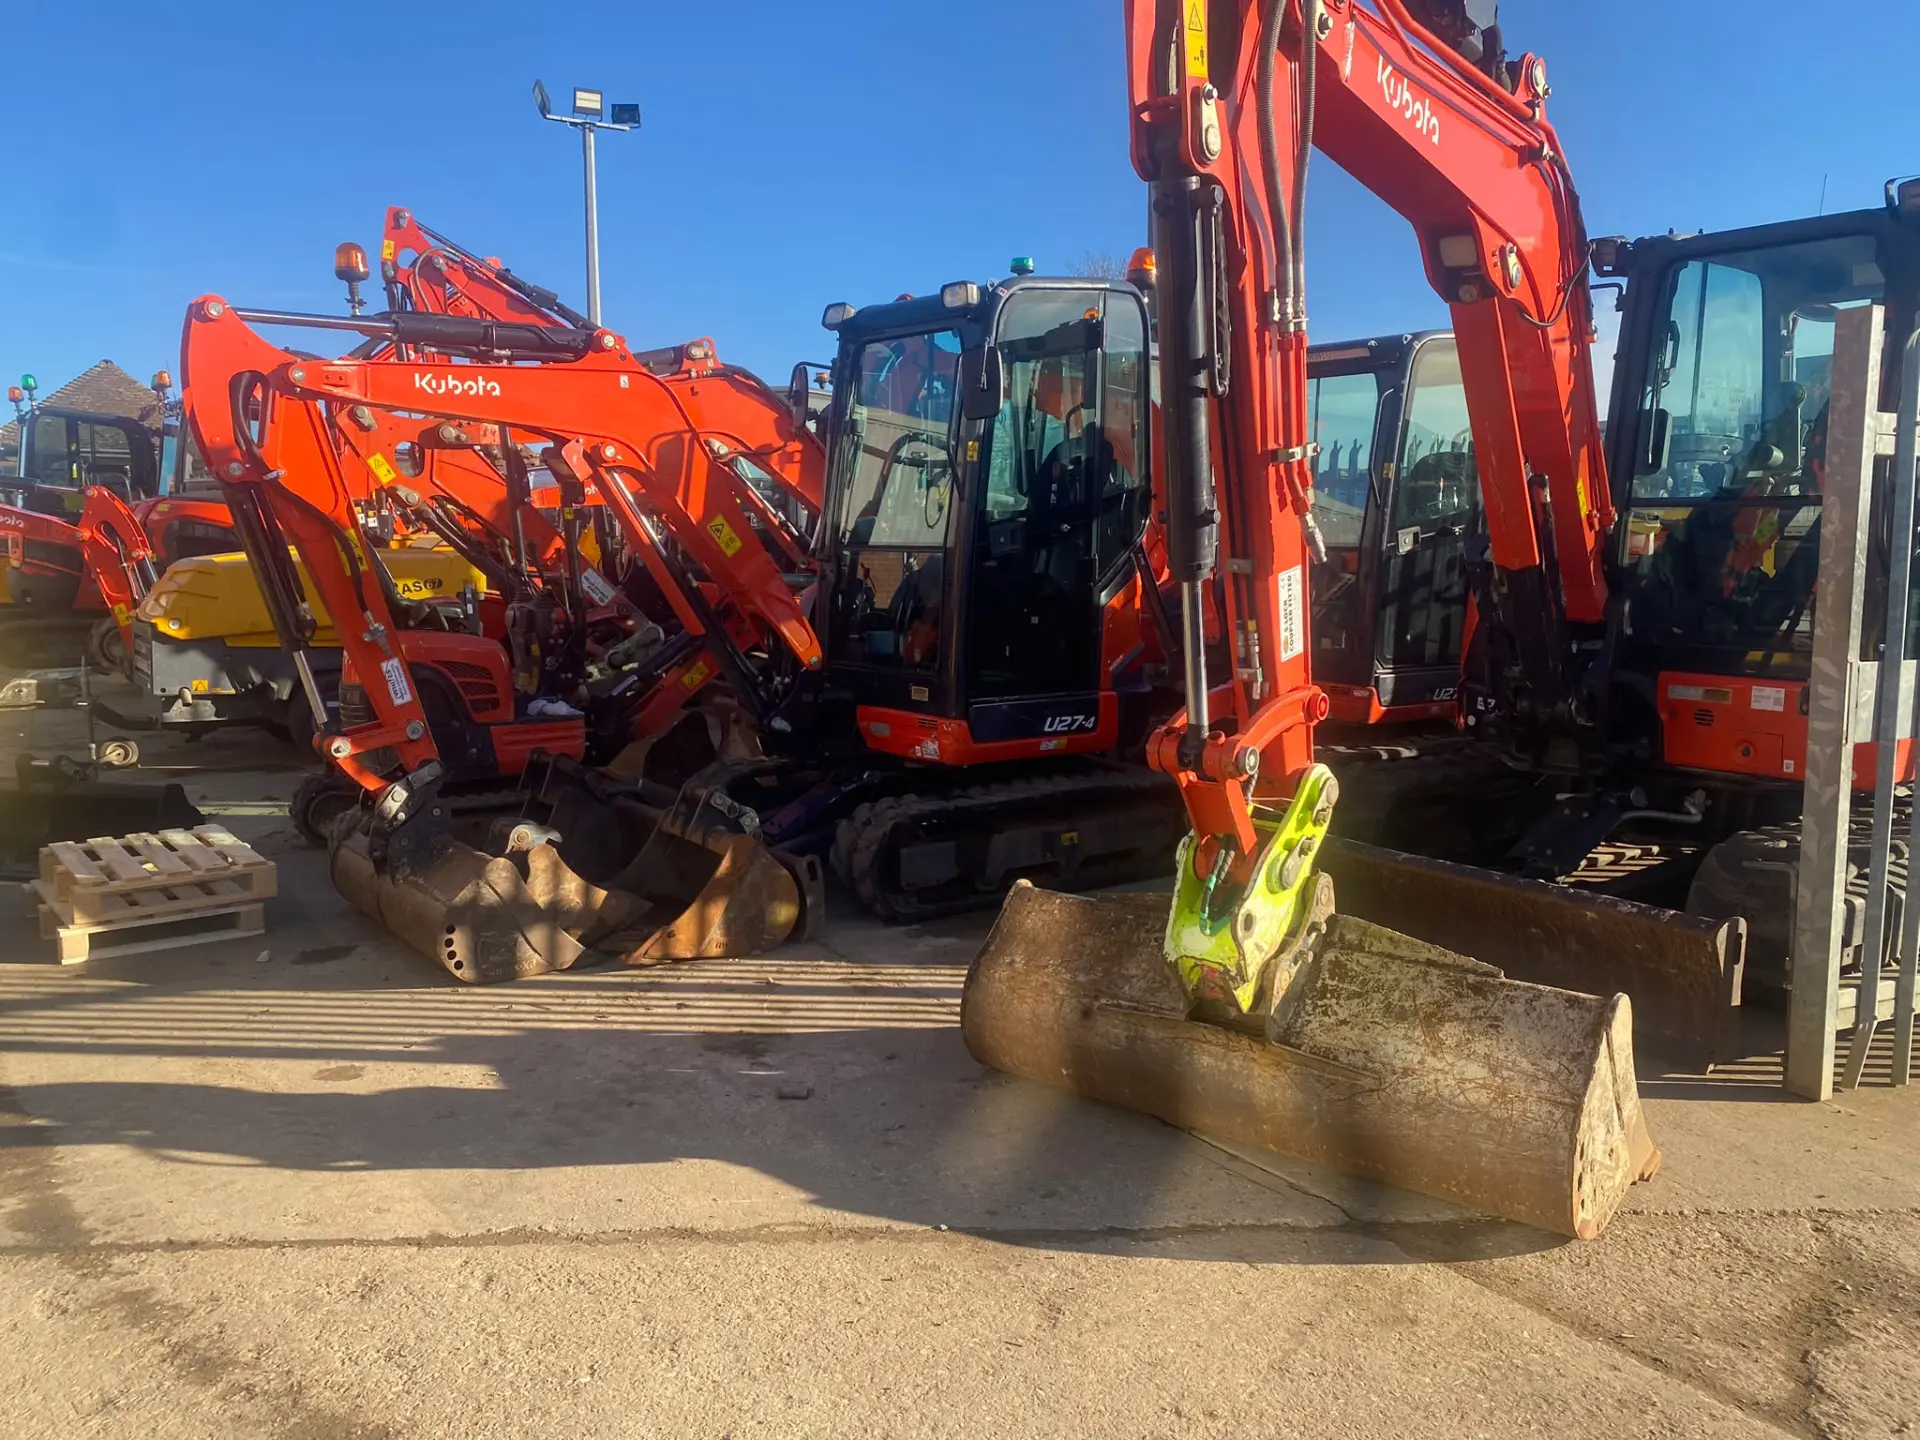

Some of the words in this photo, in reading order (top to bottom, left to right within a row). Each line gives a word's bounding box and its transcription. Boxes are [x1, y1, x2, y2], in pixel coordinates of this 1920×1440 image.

[1377, 54, 1439, 146] Kubota
[414, 372, 501, 396] Kubota
[395, 580, 422, 594] AS
[1043, 715, 1096, 732] U27-4
